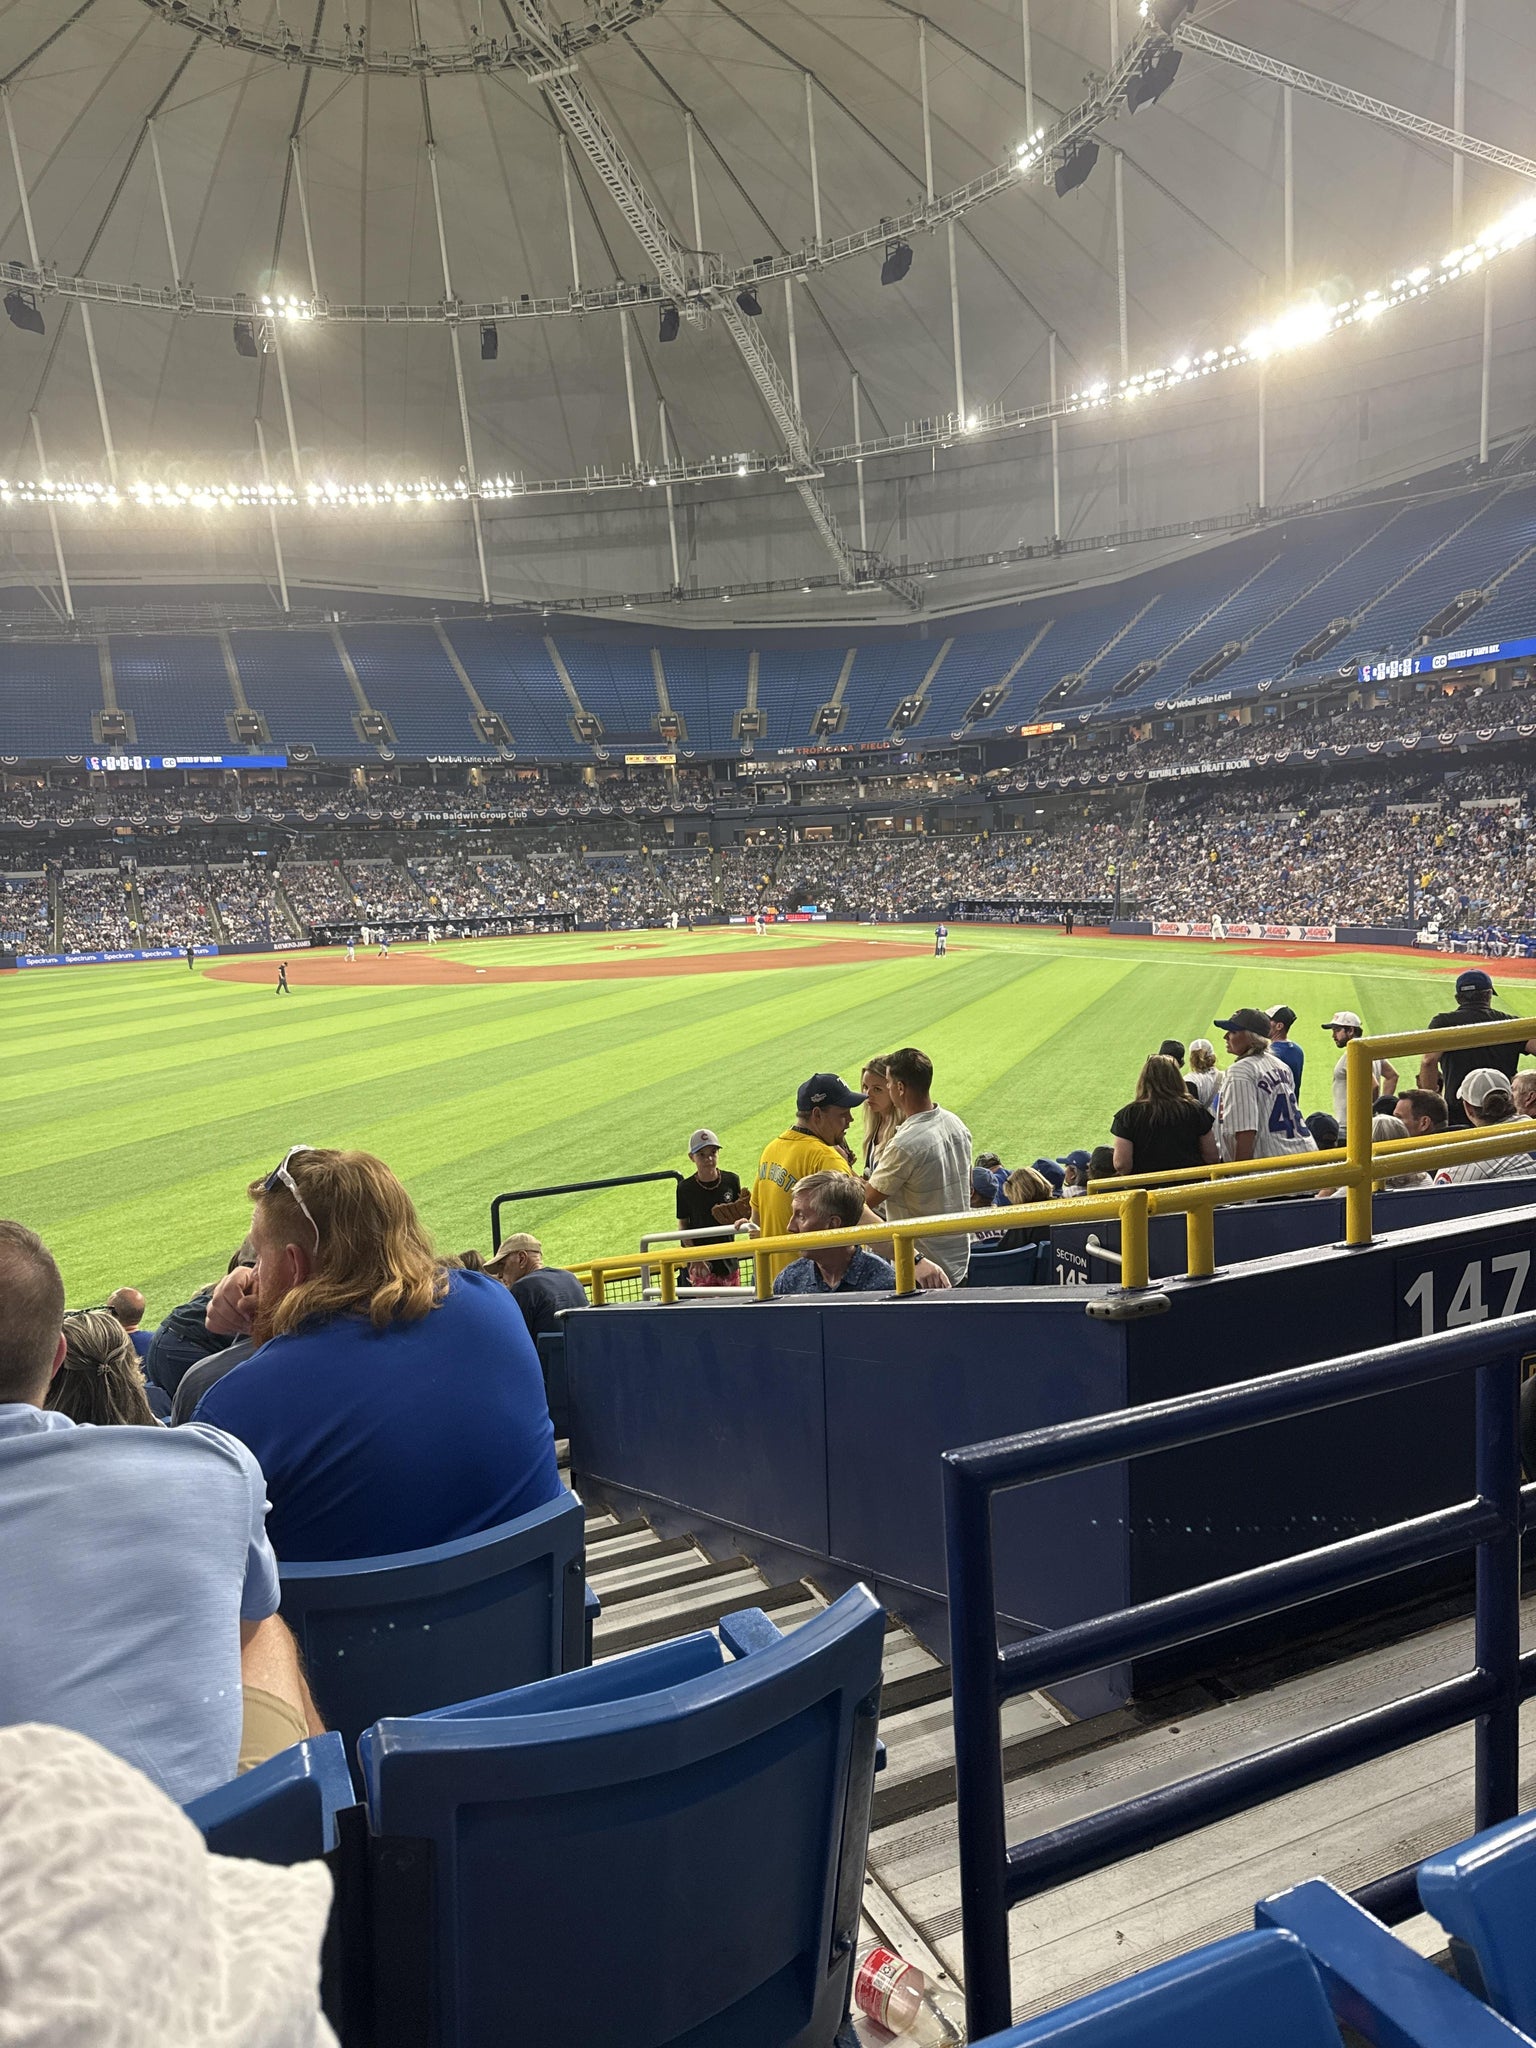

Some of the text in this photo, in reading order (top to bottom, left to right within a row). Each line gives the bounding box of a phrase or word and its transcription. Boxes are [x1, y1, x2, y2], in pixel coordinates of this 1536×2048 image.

[1434, 657, 1446, 667] CC
[1197, 696, 1213, 705] Suite
[1214, 691, 1232, 702] Level
[796, 745, 854, 755] TROPICANA
[861, 741, 890, 751] FIELD
[1148, 759, 1251, 779] REPUBLIC BANK DRAFT ROOM
[443, 812, 477, 820] Baldwin
[480, 811, 507, 821] Group
[508, 811, 528, 819] Club
[104, 953, 135, 961] Spectrum
[142, 950, 172, 958] Spectrum
[179, 948, 209, 956] Sprum
[27, 958, 58, 966] Spectrum
[66, 955, 97, 964] Spectrum
[1056, 1248, 1087, 1268] SECTION
[1403, 1250, 1531, 1338] 147
